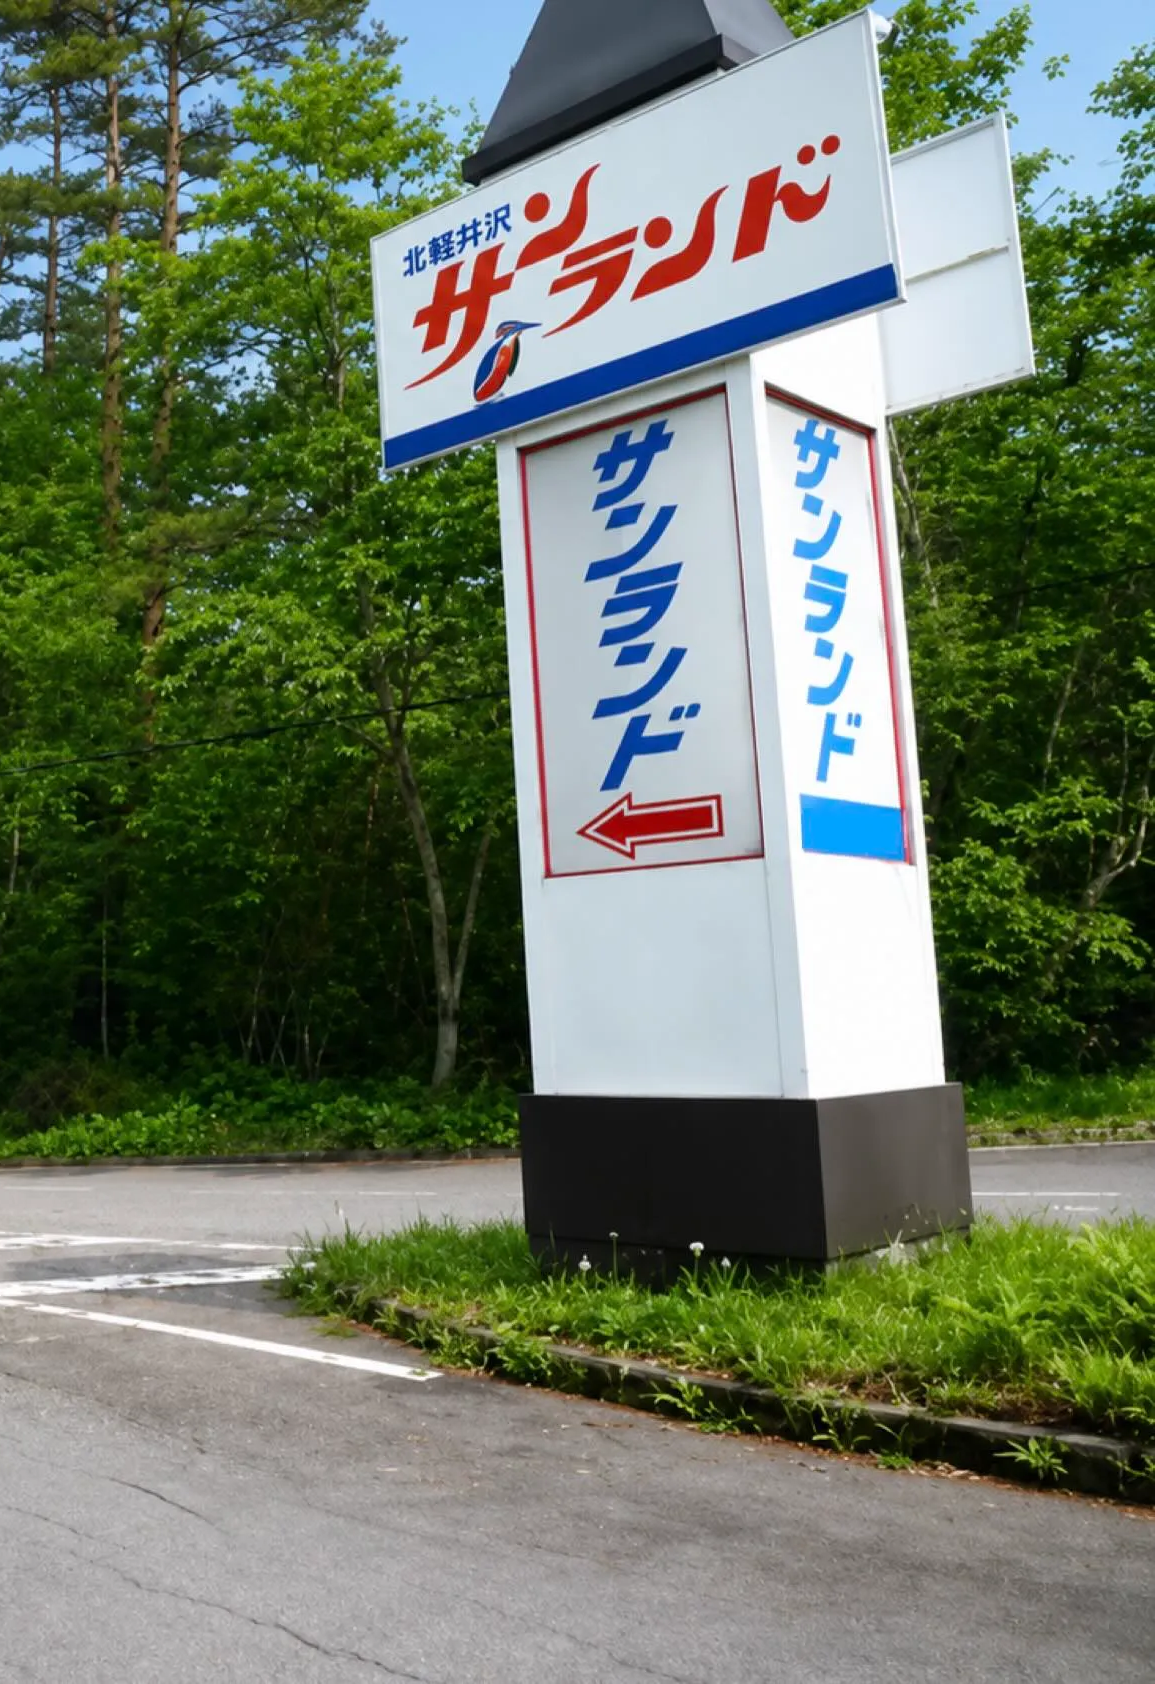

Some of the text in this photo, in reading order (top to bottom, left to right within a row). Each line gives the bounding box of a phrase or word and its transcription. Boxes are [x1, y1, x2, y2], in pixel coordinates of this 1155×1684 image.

[403, 203, 511, 277] 北軽井沢
[404, 135, 840, 390] サンランド
[584, 419, 701, 792] サンランド
[793, 419, 862, 783] サンランド
